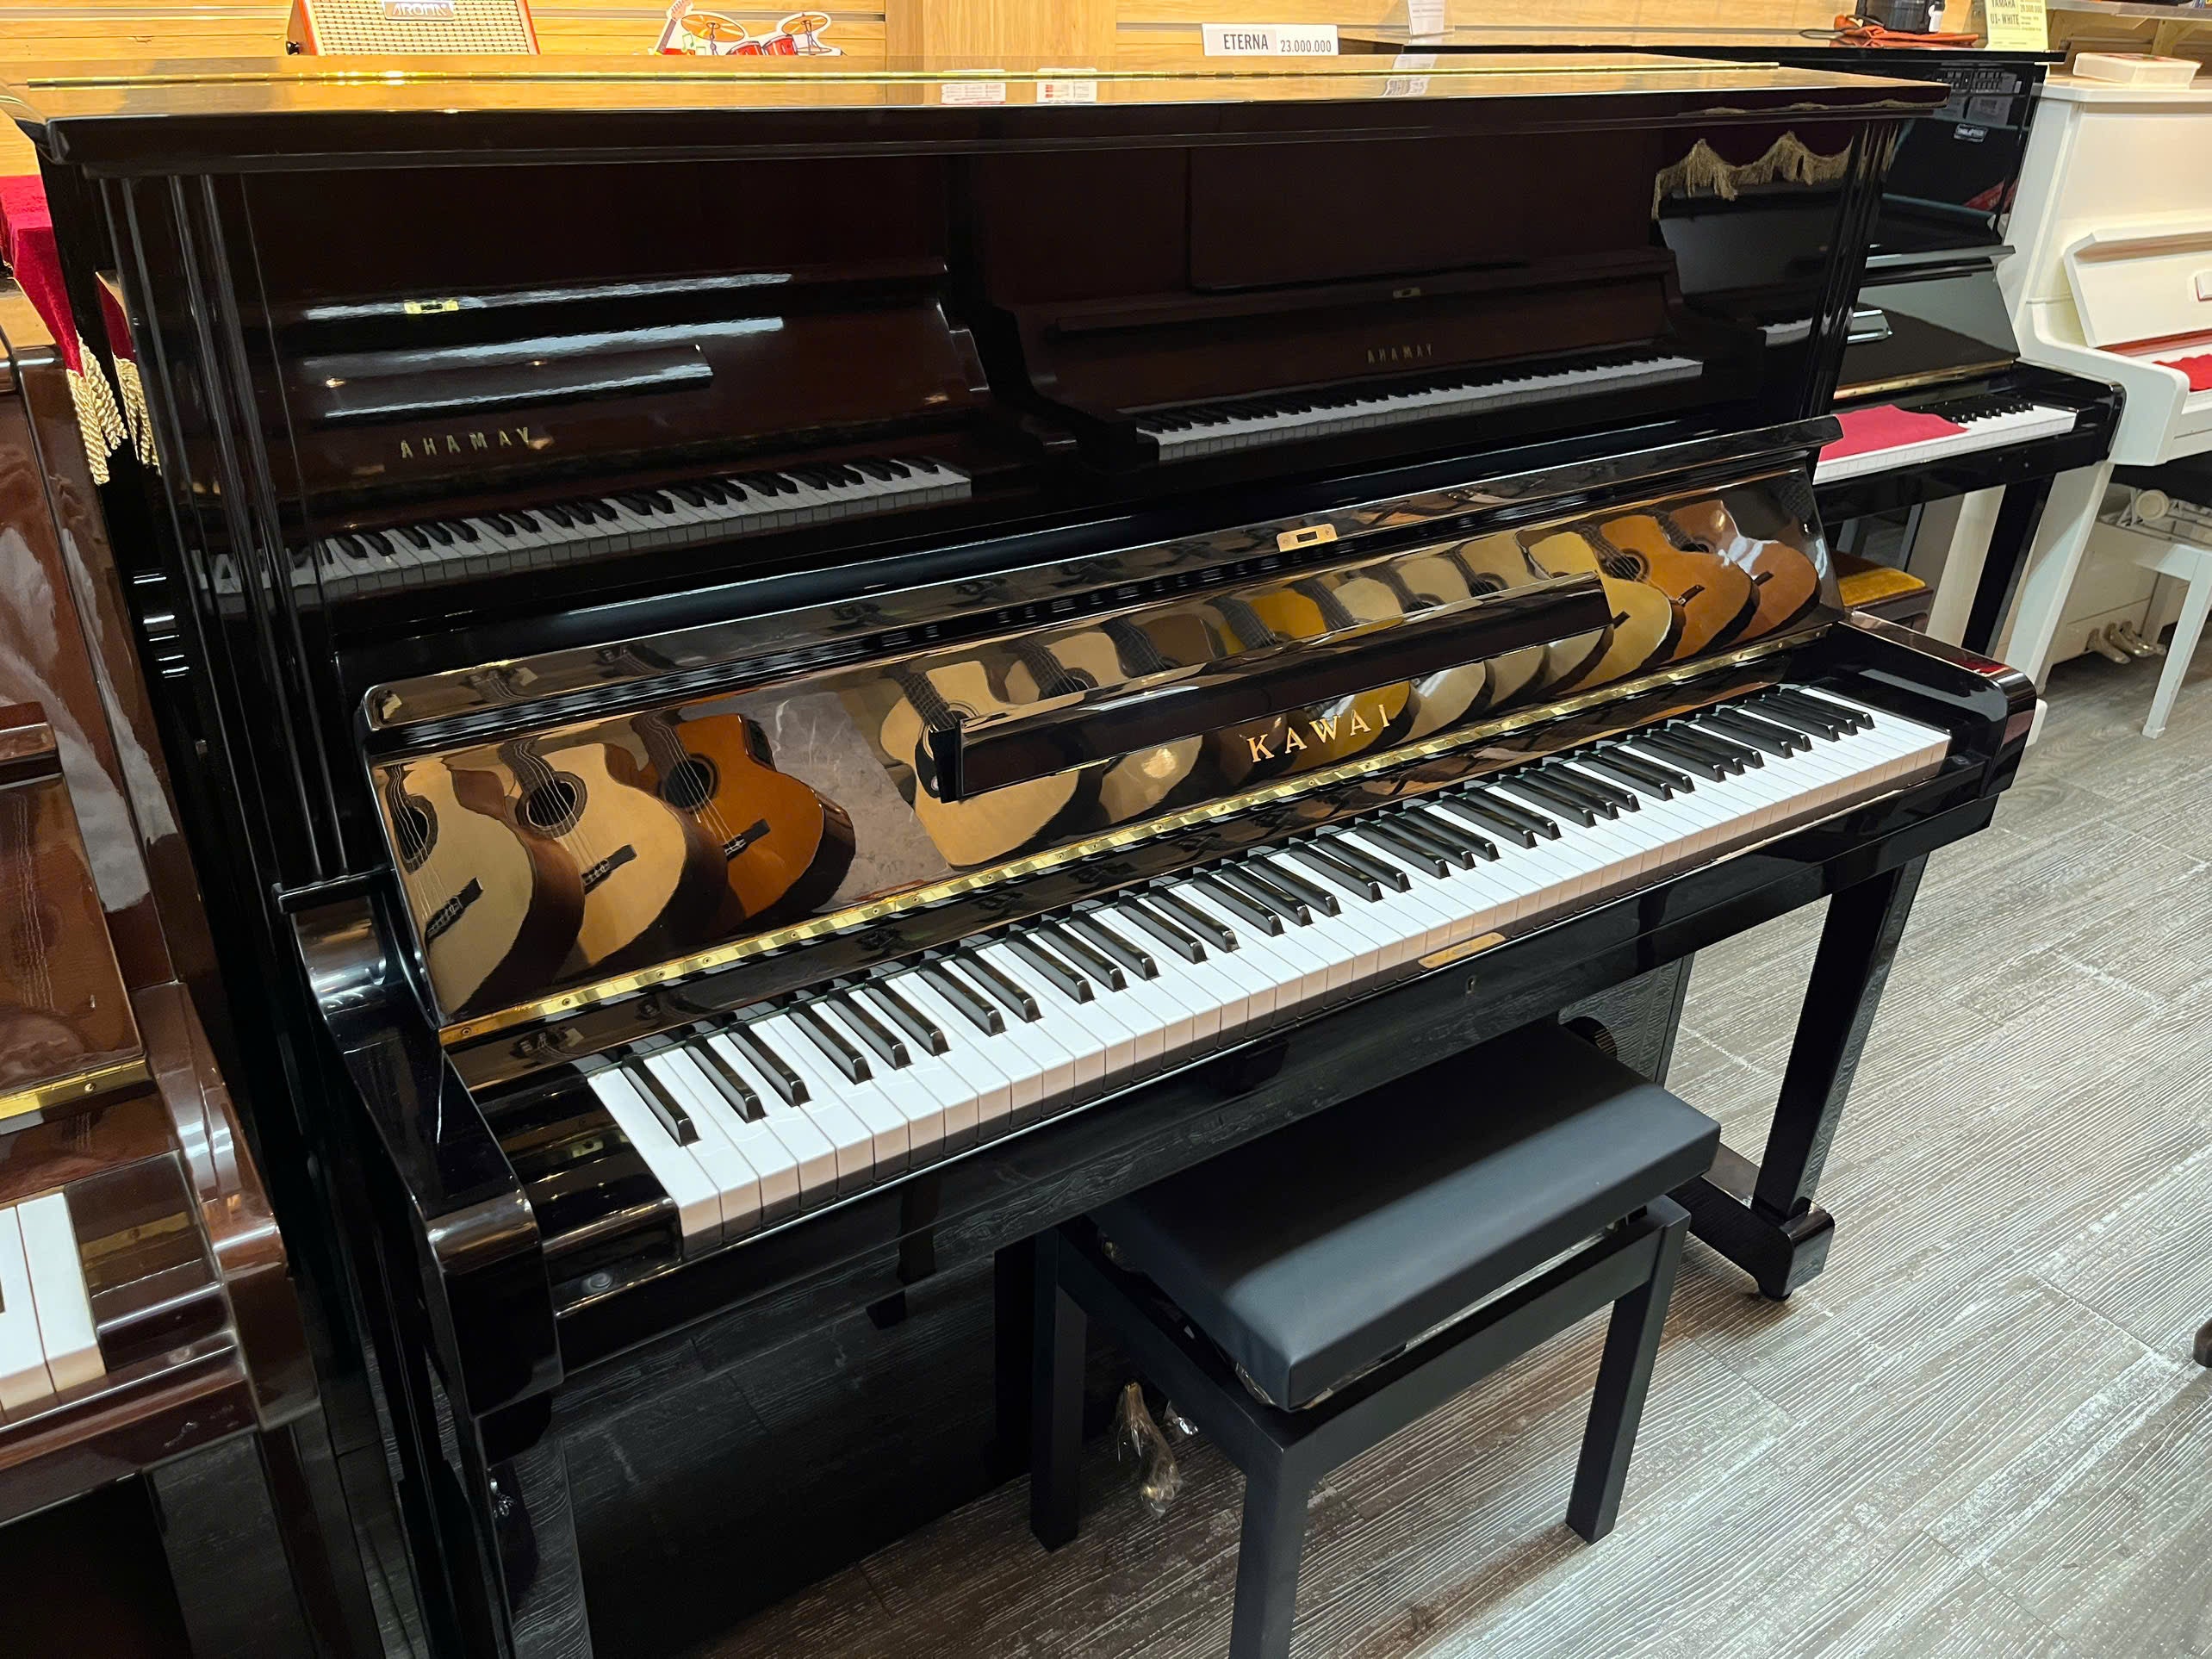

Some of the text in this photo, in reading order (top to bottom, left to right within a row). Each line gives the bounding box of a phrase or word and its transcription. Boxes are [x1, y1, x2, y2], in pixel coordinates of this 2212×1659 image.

[1223, 34, 1332, 53] ETERNA 23.000.000
[1246, 704, 1390, 763] KAWAI
